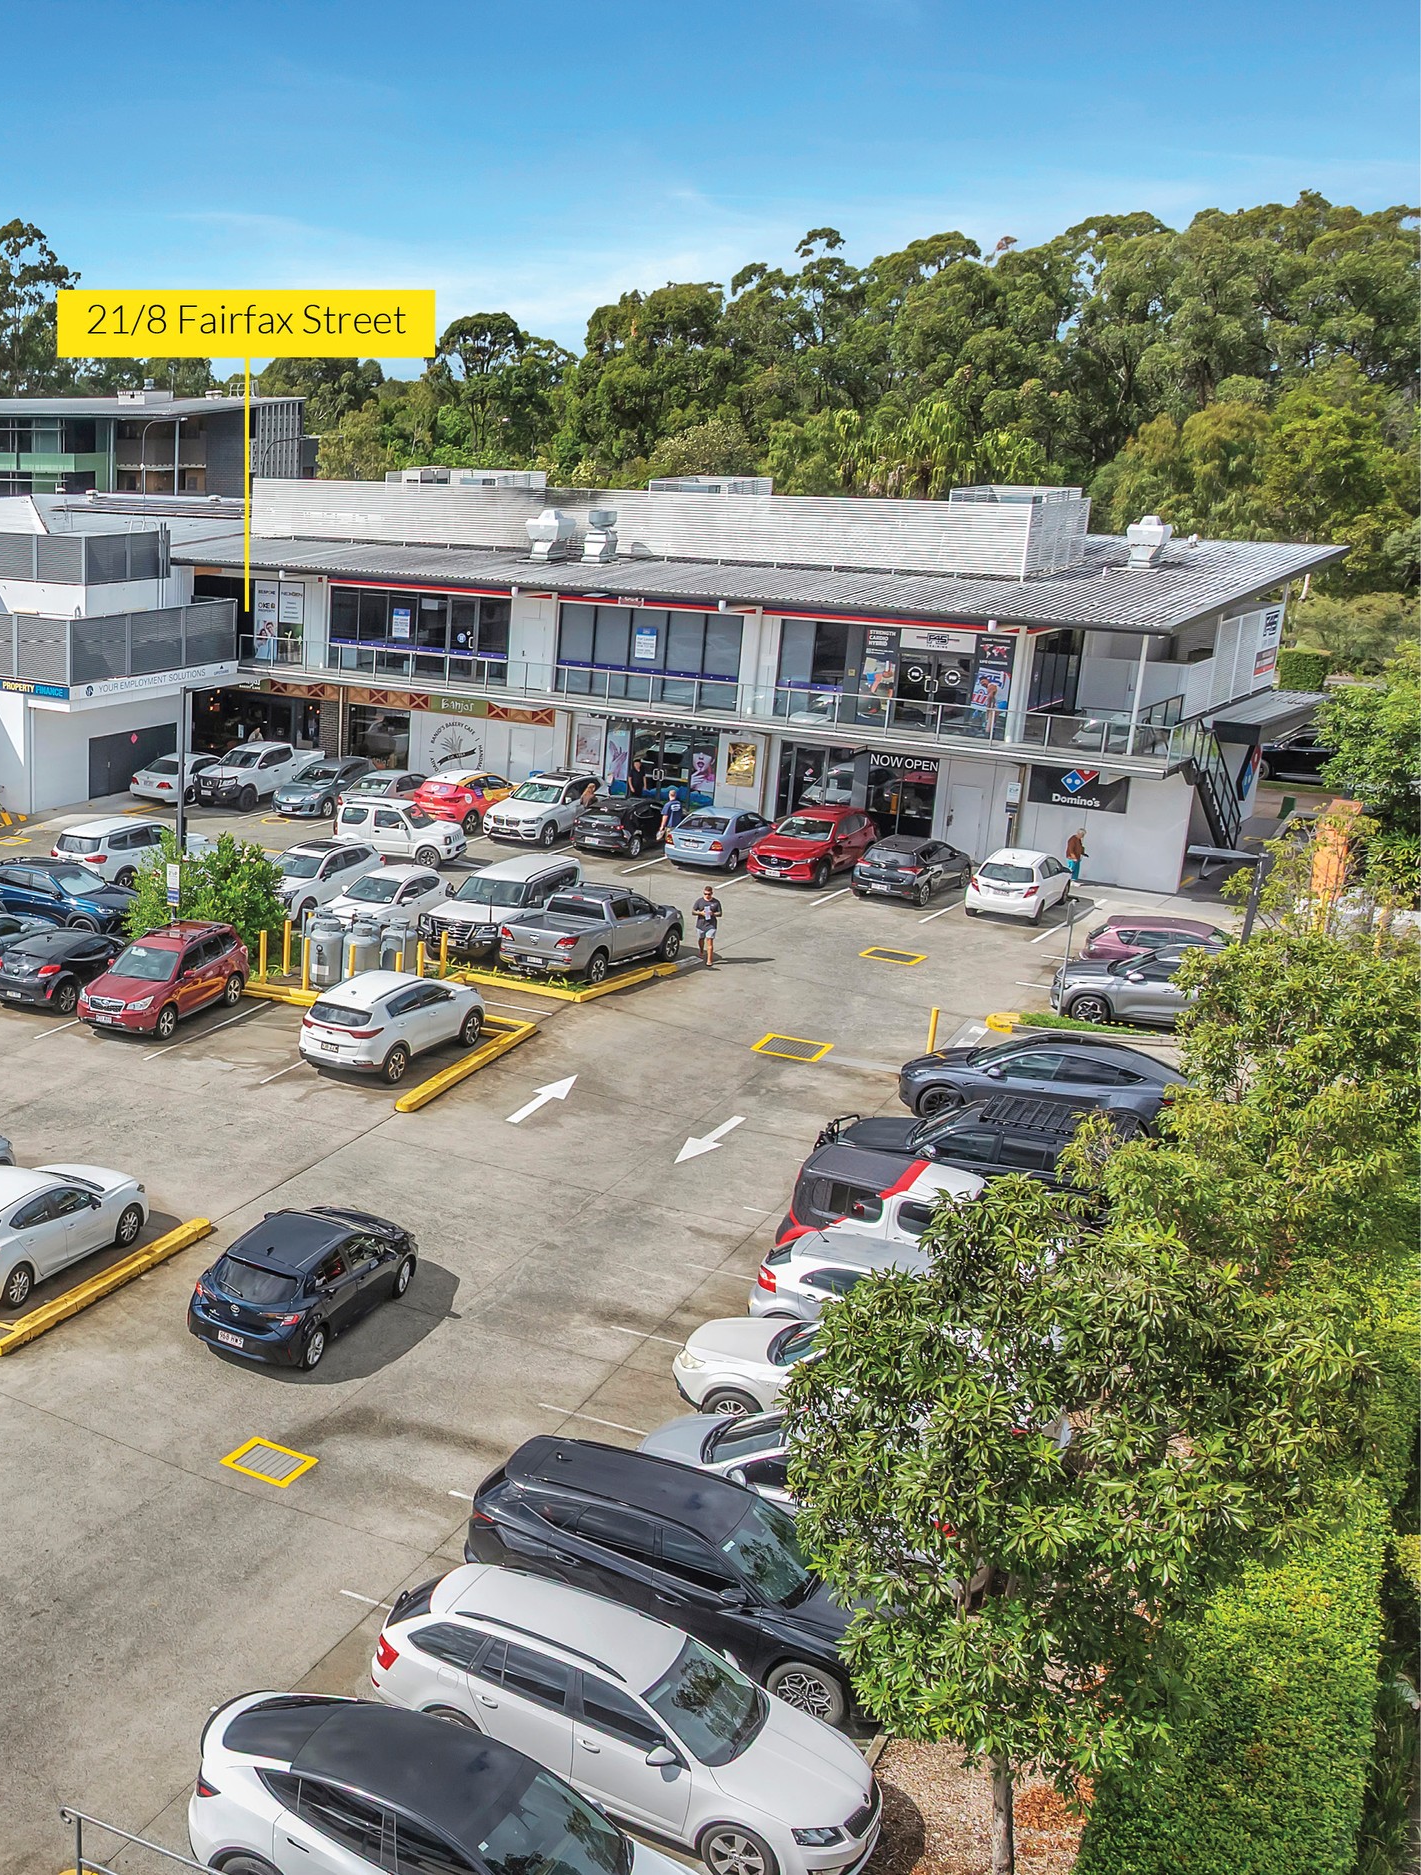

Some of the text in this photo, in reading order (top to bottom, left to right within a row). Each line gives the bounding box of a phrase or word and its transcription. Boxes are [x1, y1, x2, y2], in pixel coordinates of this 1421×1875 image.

[98, 669, 206, 693] YOUR EMPLOYMENT SOLUTIONS
[2, 682, 35, 693] PROPERTY
[35, 684, 63, 697] FINANCE
[441, 698, 474, 713] Banjo's
[431, 725, 446, 744] BANJO'S
[870, 753, 939, 771] NOW OPEN
[1052, 793, 1100, 808] Domino's
[219, 1331, 230, 1341] 968
